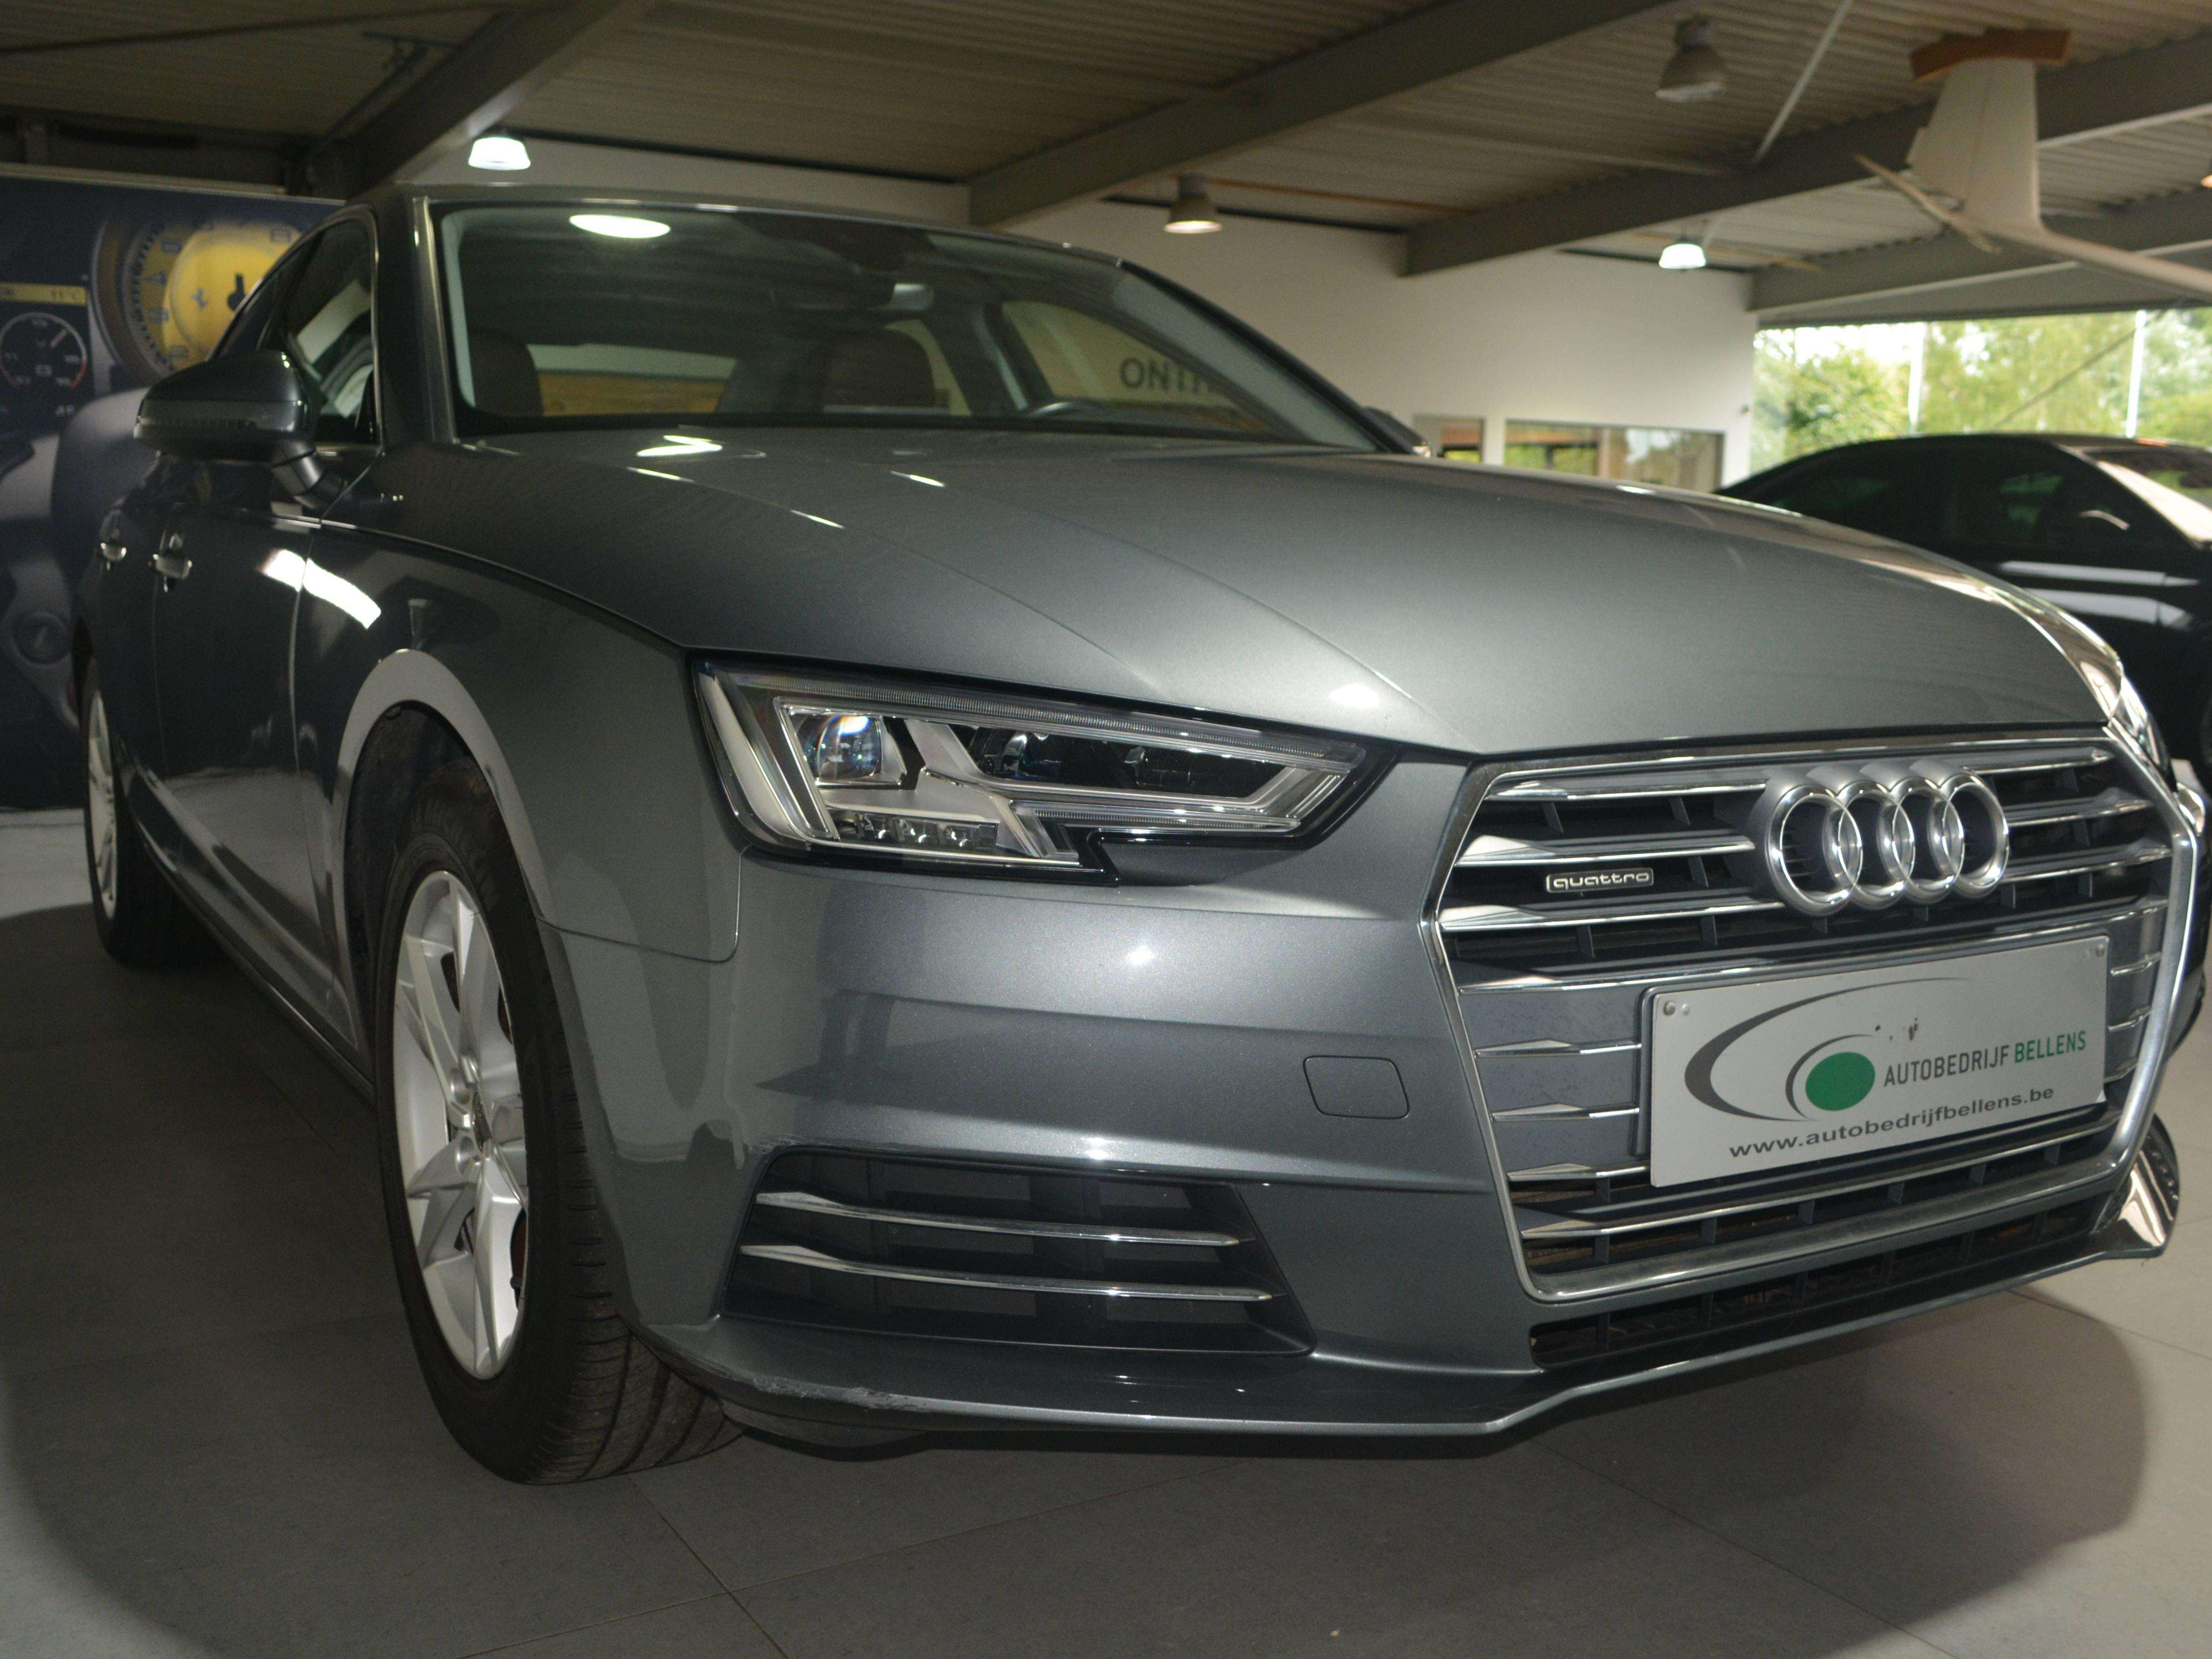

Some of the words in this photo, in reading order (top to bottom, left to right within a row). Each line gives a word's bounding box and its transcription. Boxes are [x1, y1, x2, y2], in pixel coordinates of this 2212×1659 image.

[1552, 872, 1650, 890] quattro
[1884, 1045, 2010, 1087] AUTOBEDRIJF
[2014, 1030, 2087, 1063] BELLENS
[1728, 1086, 2055, 1158] www.autobedrijfbellens.be
